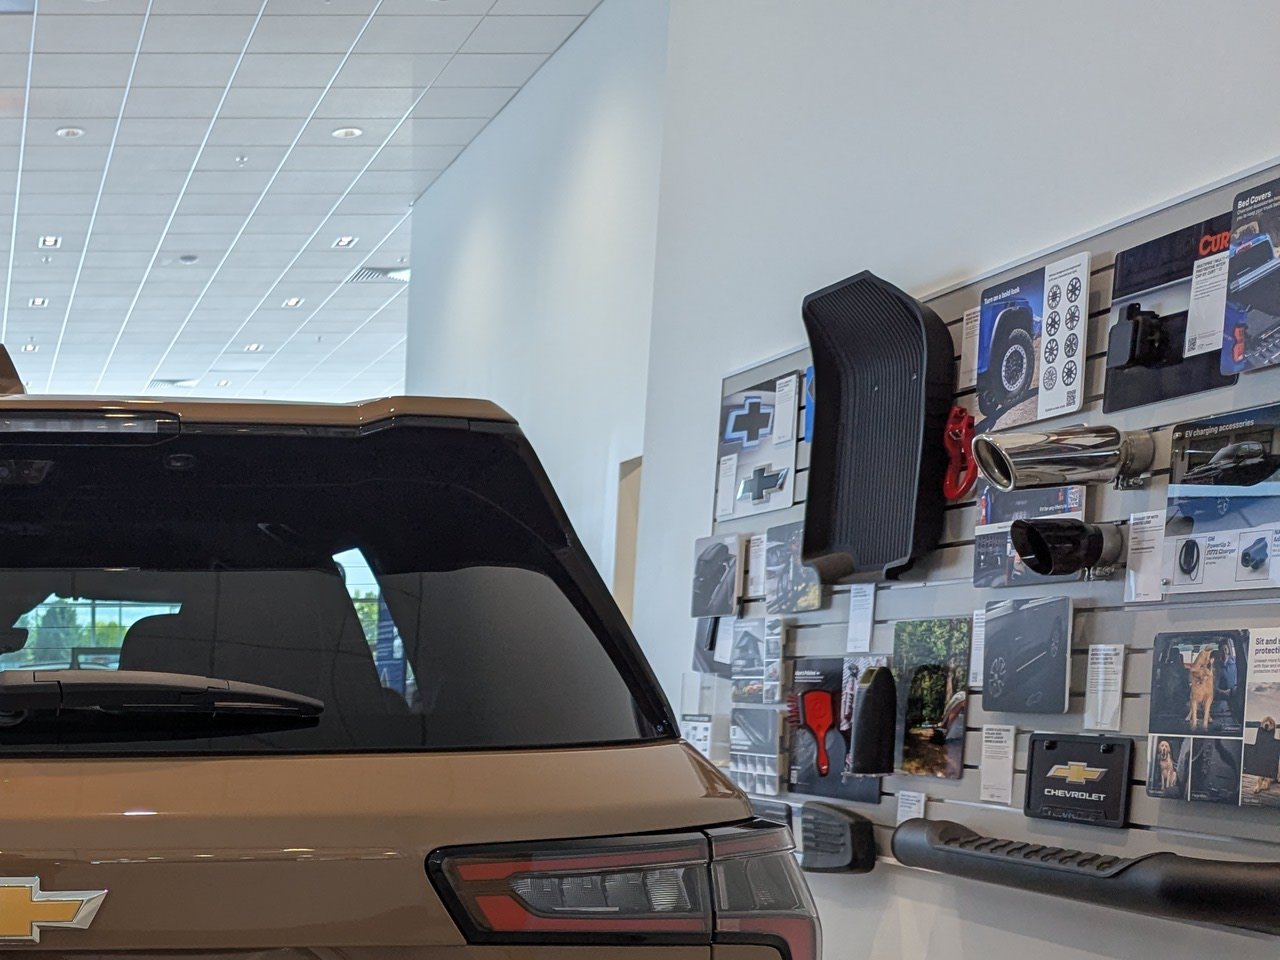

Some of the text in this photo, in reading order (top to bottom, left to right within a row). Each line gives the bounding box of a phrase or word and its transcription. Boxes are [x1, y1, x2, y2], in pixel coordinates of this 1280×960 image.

[1238, 198, 1250, 209] Bed
[1250, 191, 1271, 204] Covers
[1199, 231, 1230, 256] CUR
[1185, 419, 1254, 438] EV charging accessories
[1265, 637, 1277, 645] and
[1255, 648, 1280, 656] protecti
[1044, 788, 1106, 801] CHEVROLET
